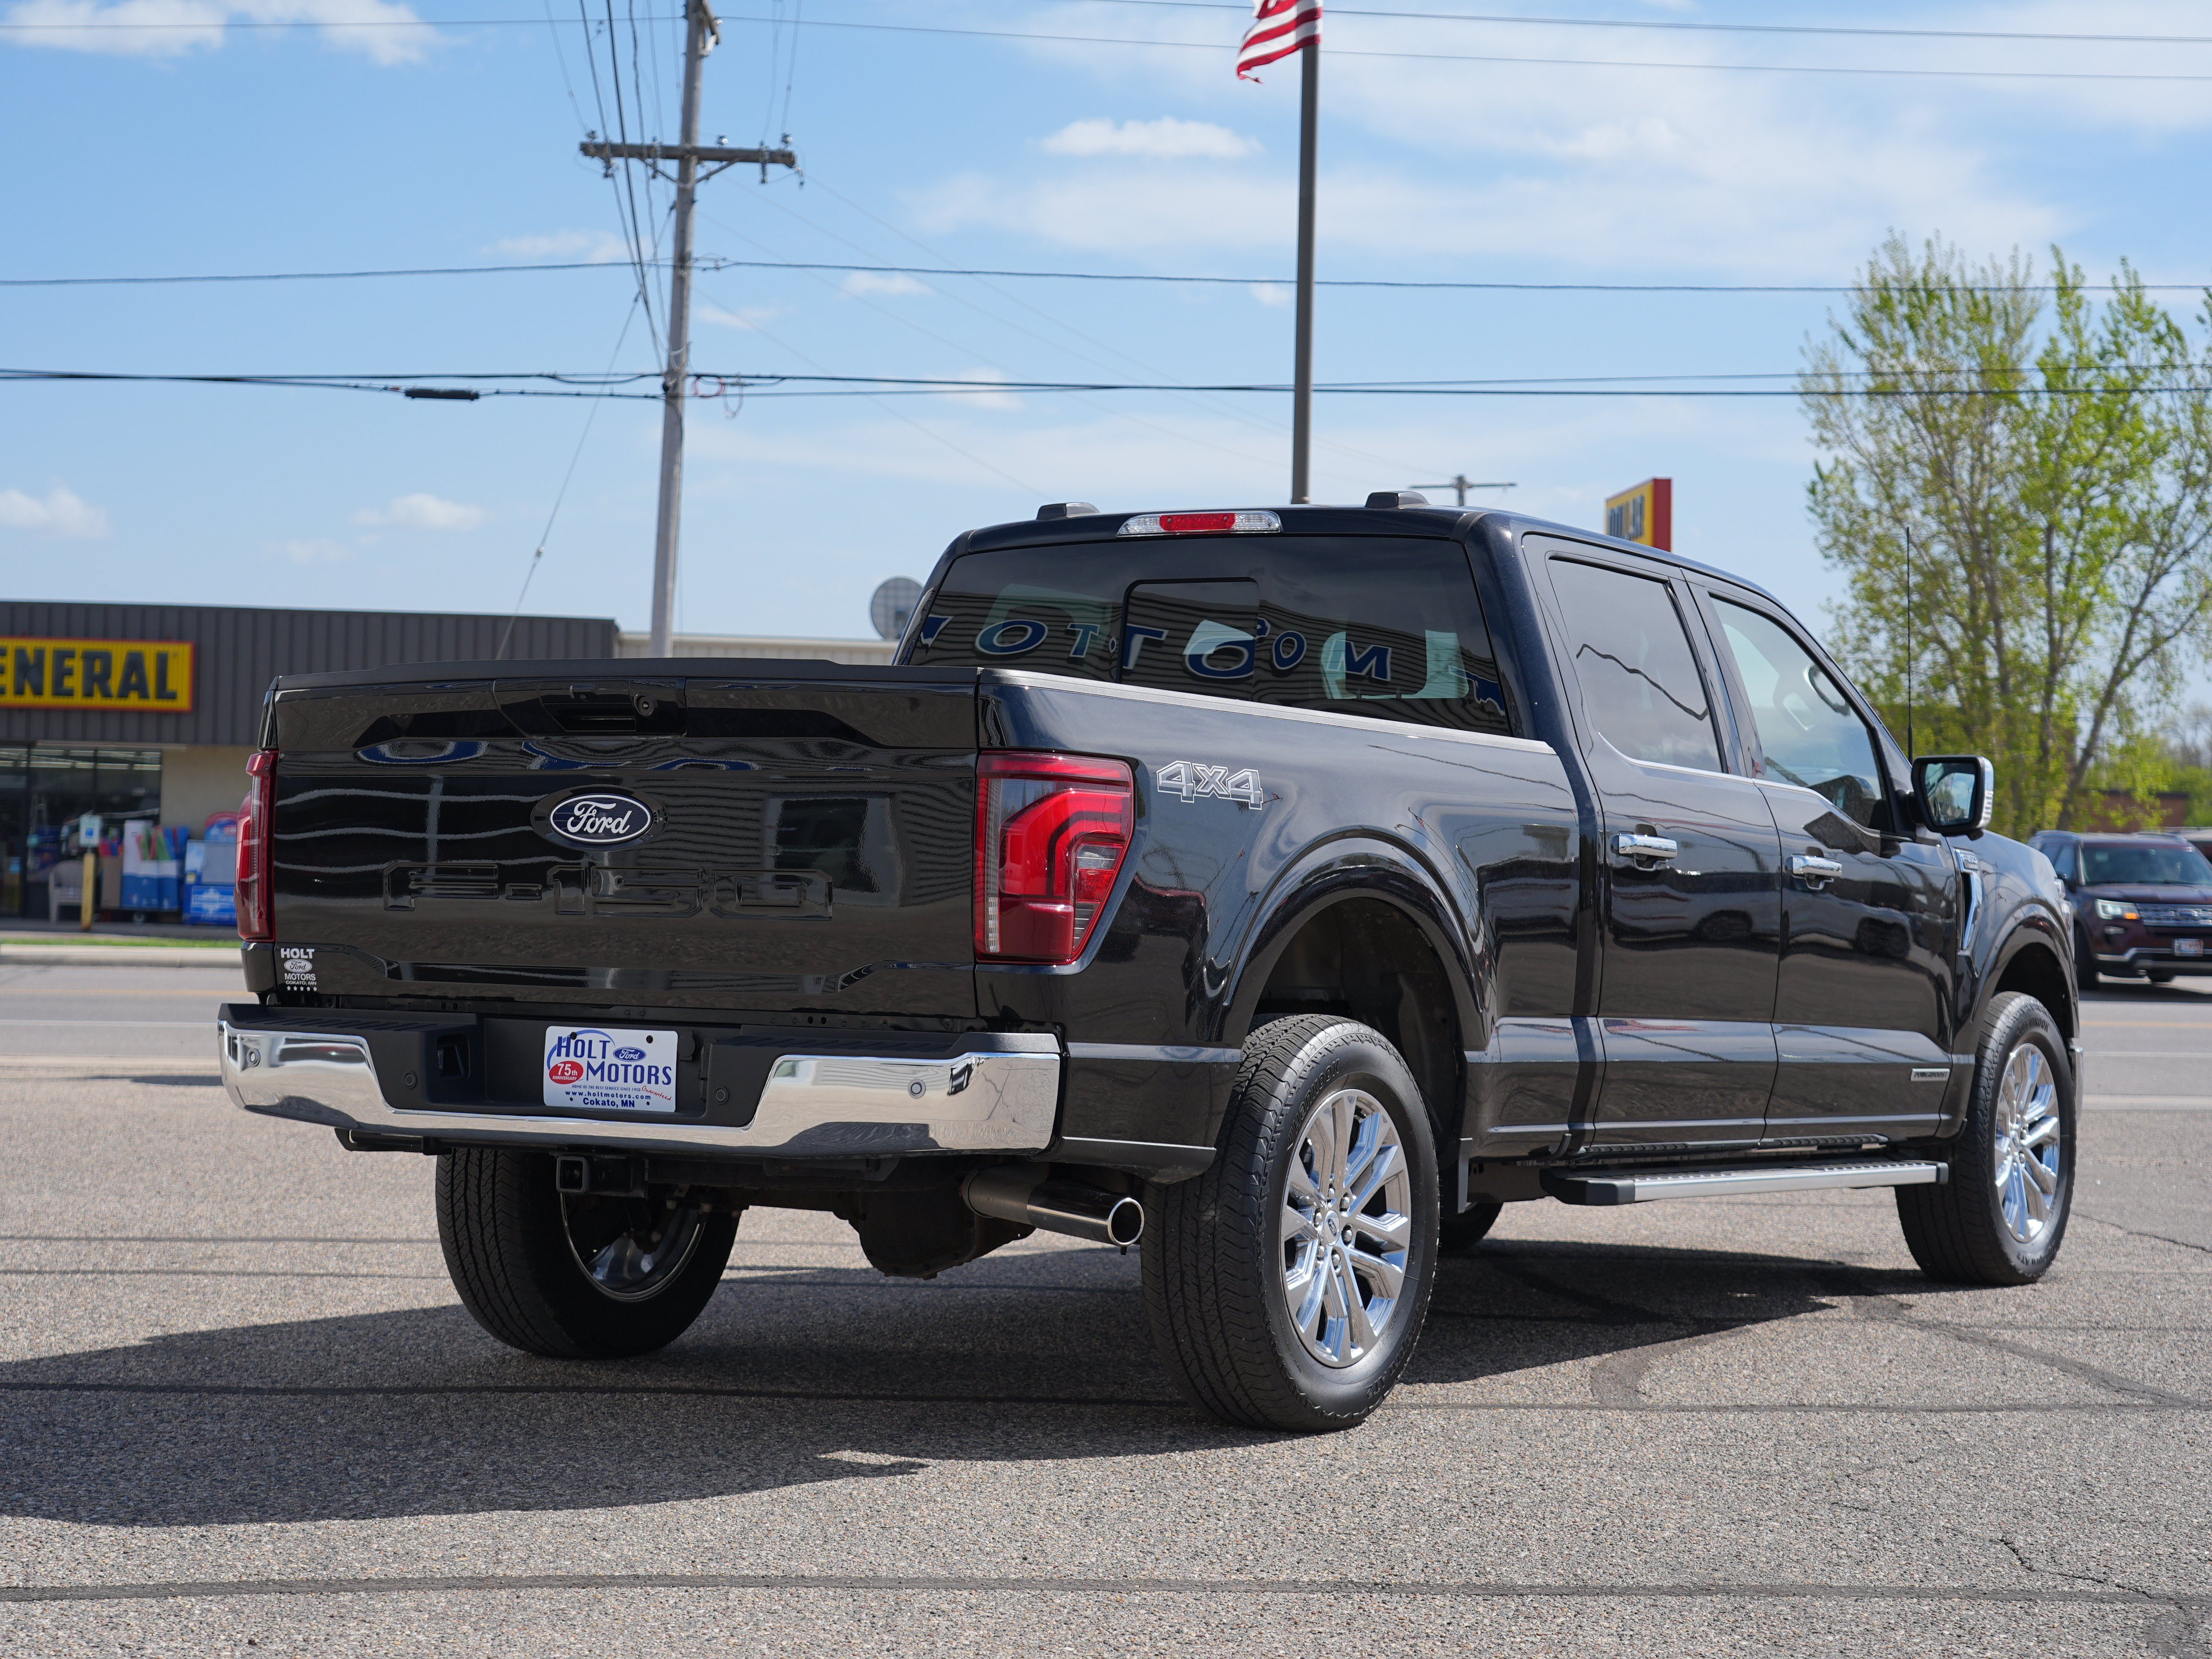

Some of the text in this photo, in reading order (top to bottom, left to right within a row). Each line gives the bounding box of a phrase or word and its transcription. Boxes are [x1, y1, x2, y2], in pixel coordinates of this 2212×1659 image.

[0, 648, 178, 700] NERAL
[567, 800, 633, 834] Ford
[383, 863, 833, 921] F-150
[281, 948, 315, 959] HOLT
[290, 960, 307, 970] Ford
[556, 1036, 610, 1059] HOLT
[557, 1063, 578, 1076] 75th
[586, 1060, 672, 1085] MOTORS
[565, 1090, 651, 1100] www.holtmotors.com
[642, 1085, 672, 1101] Guaranteed
[583, 1097, 635, 1108] Cokato, MN
